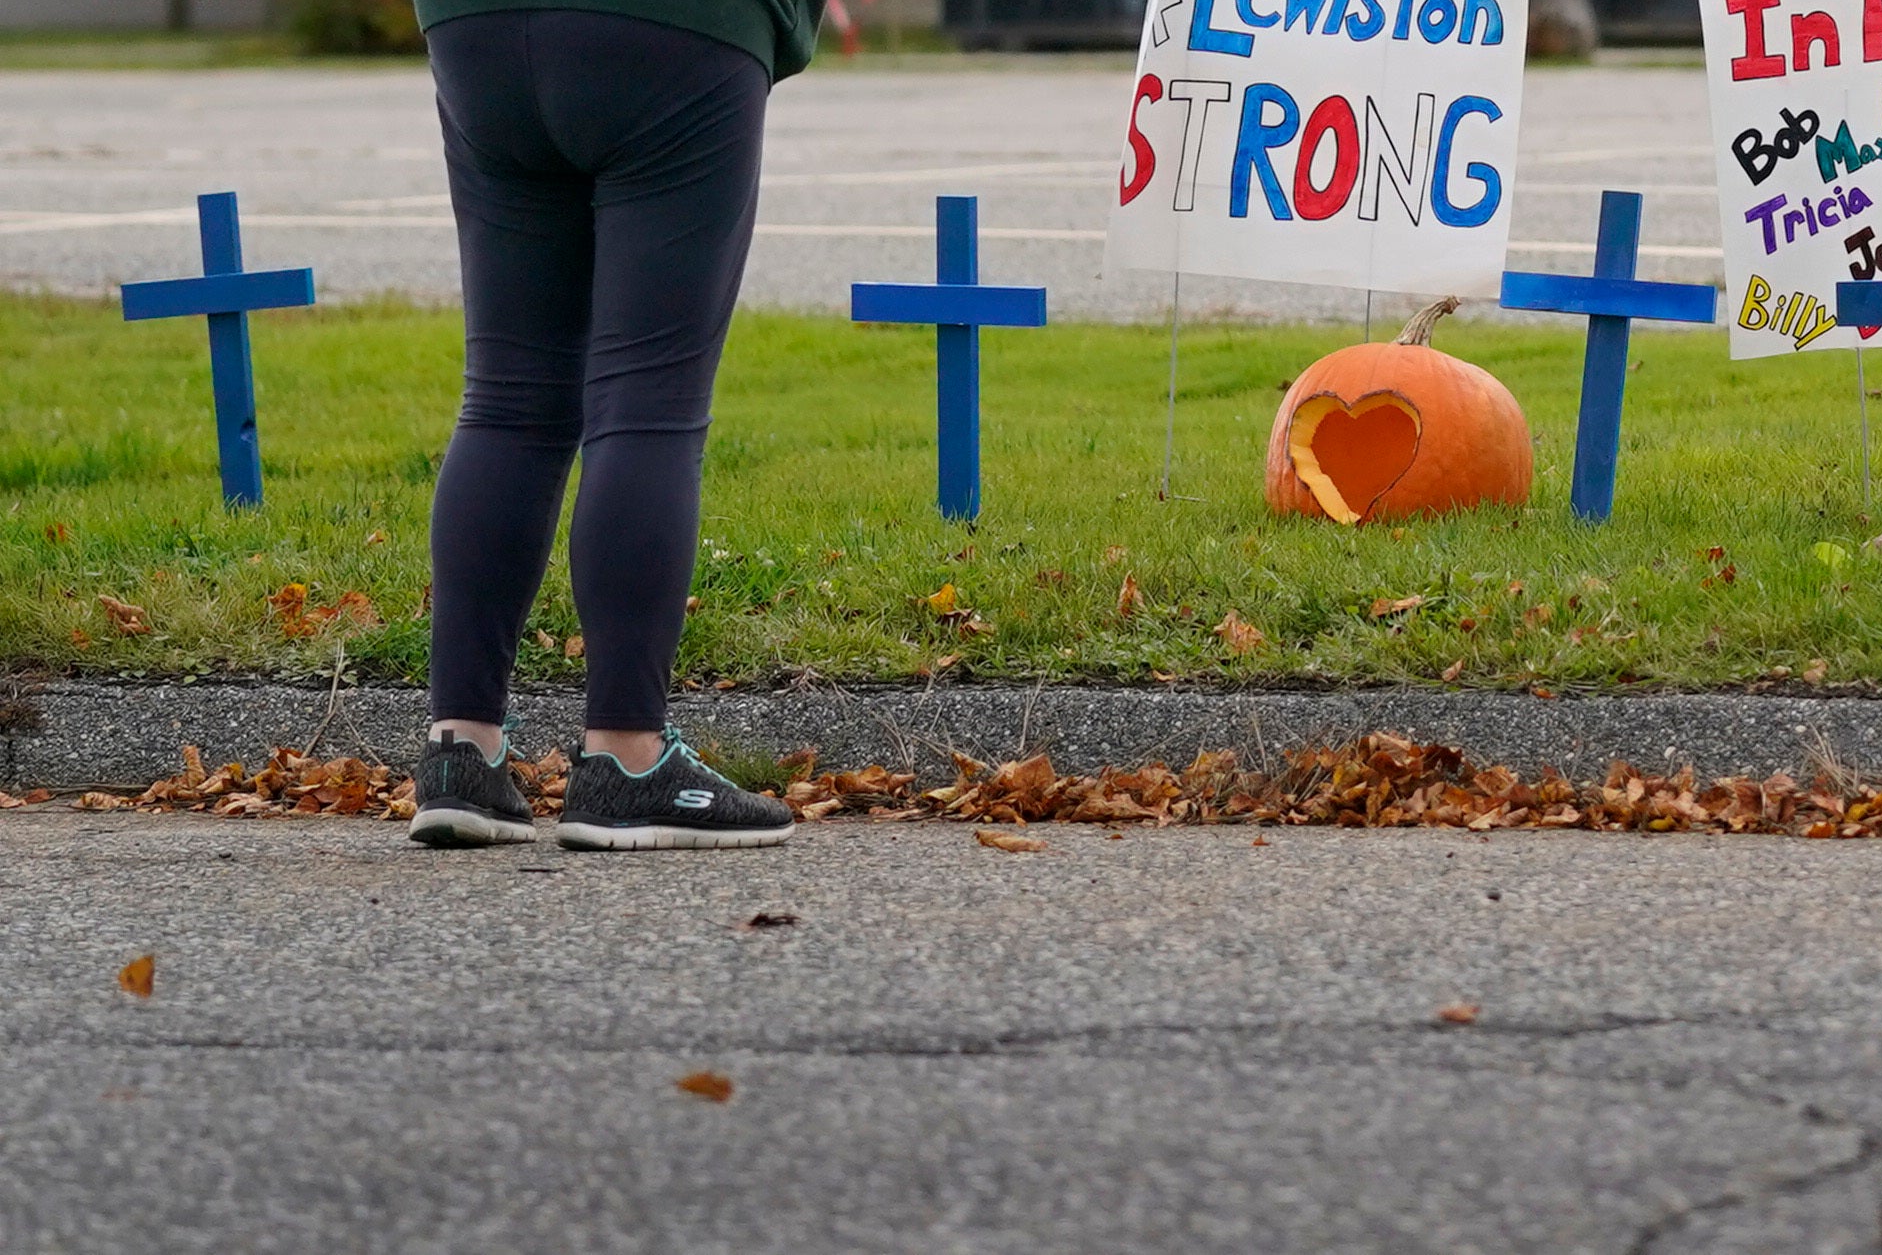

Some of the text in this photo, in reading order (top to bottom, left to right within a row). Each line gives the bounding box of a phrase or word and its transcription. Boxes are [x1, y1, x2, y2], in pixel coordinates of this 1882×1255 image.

[1120, 73, 1503, 228] STRONG
[1732, 108, 1823, 185] Bob
[1745, 186, 1873, 255] Tricia
[1738, 275, 1839, 351] Billy
